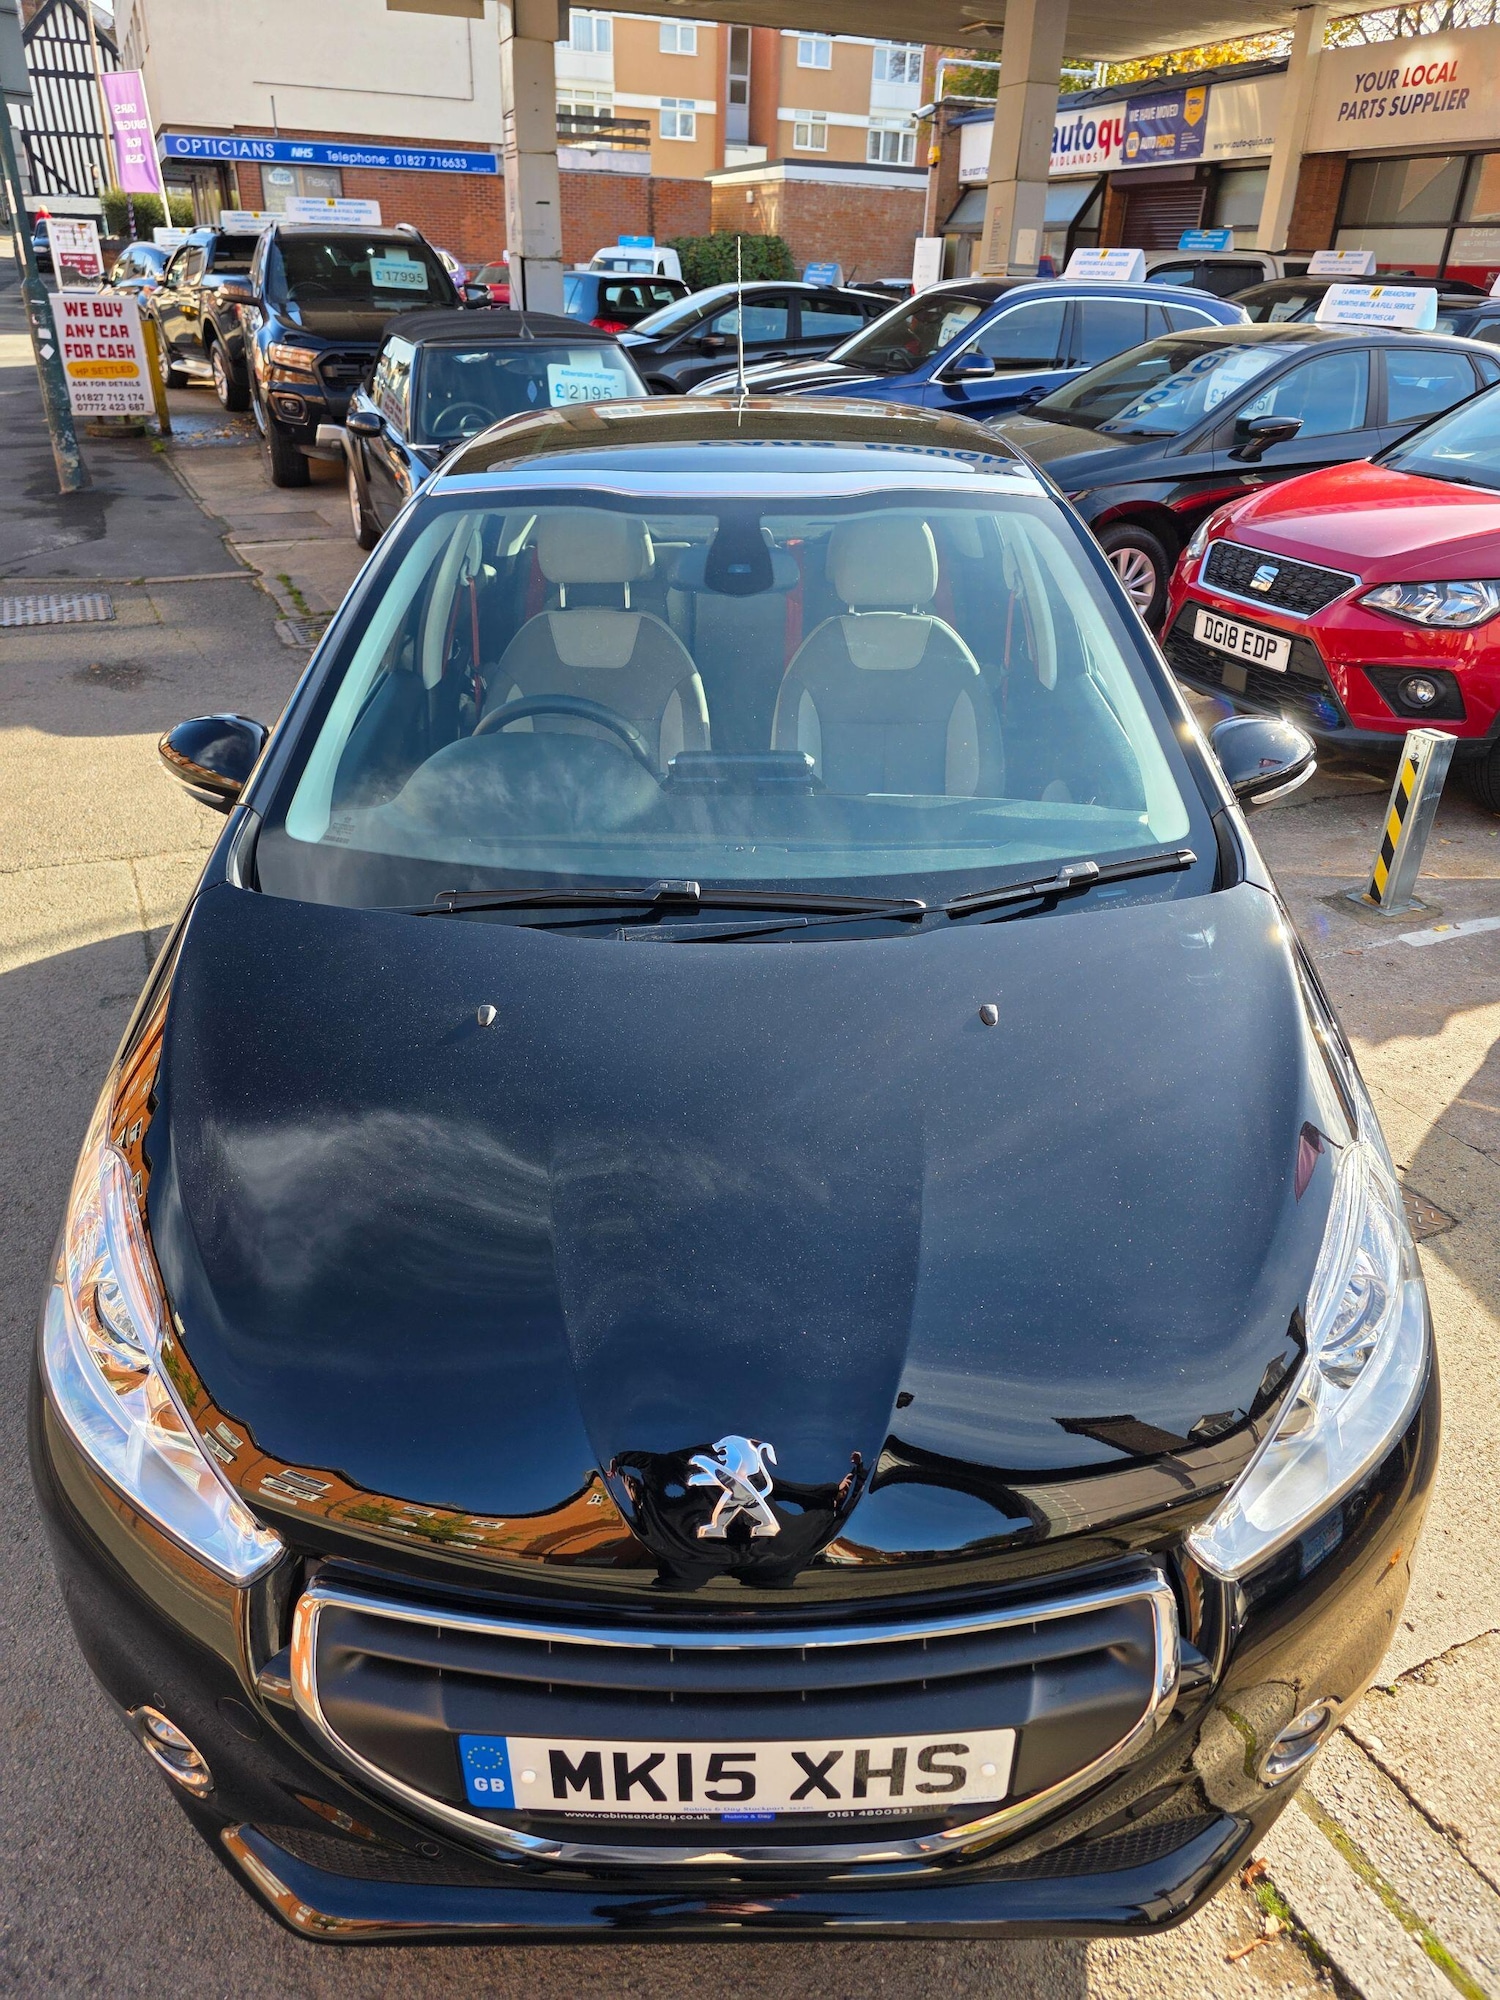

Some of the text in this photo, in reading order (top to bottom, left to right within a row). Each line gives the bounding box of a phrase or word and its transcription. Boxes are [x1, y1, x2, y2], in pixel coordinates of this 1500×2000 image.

[1355, 60, 1458, 93] YOUR LOCAL
[1337, 88, 1470, 121] PARTS SUPPLIER
[175, 138, 468, 169] OPTICIANS NHS Telephone: 01827 716633
[64, 302, 123, 318] WE BUY
[65, 324, 130, 338] ANY CAR
[64, 344, 136, 359] FOR CASH
[75, 365, 134, 376] HP SETTLED
[75, 393, 144, 401] 01827 712 174
[77, 403, 145, 411] 07772 423 687
[1203, 616, 1278, 661] DG18 EDP
[548, 1743, 970, 1802] MK15 XHS
[474, 1777, 505, 1793] GB
[564, 1811, 711, 1821] www.robinsandday.co.uk
[827, 1811, 855, 1819] 0161
[858, 1807, 913, 1817] 4800831
